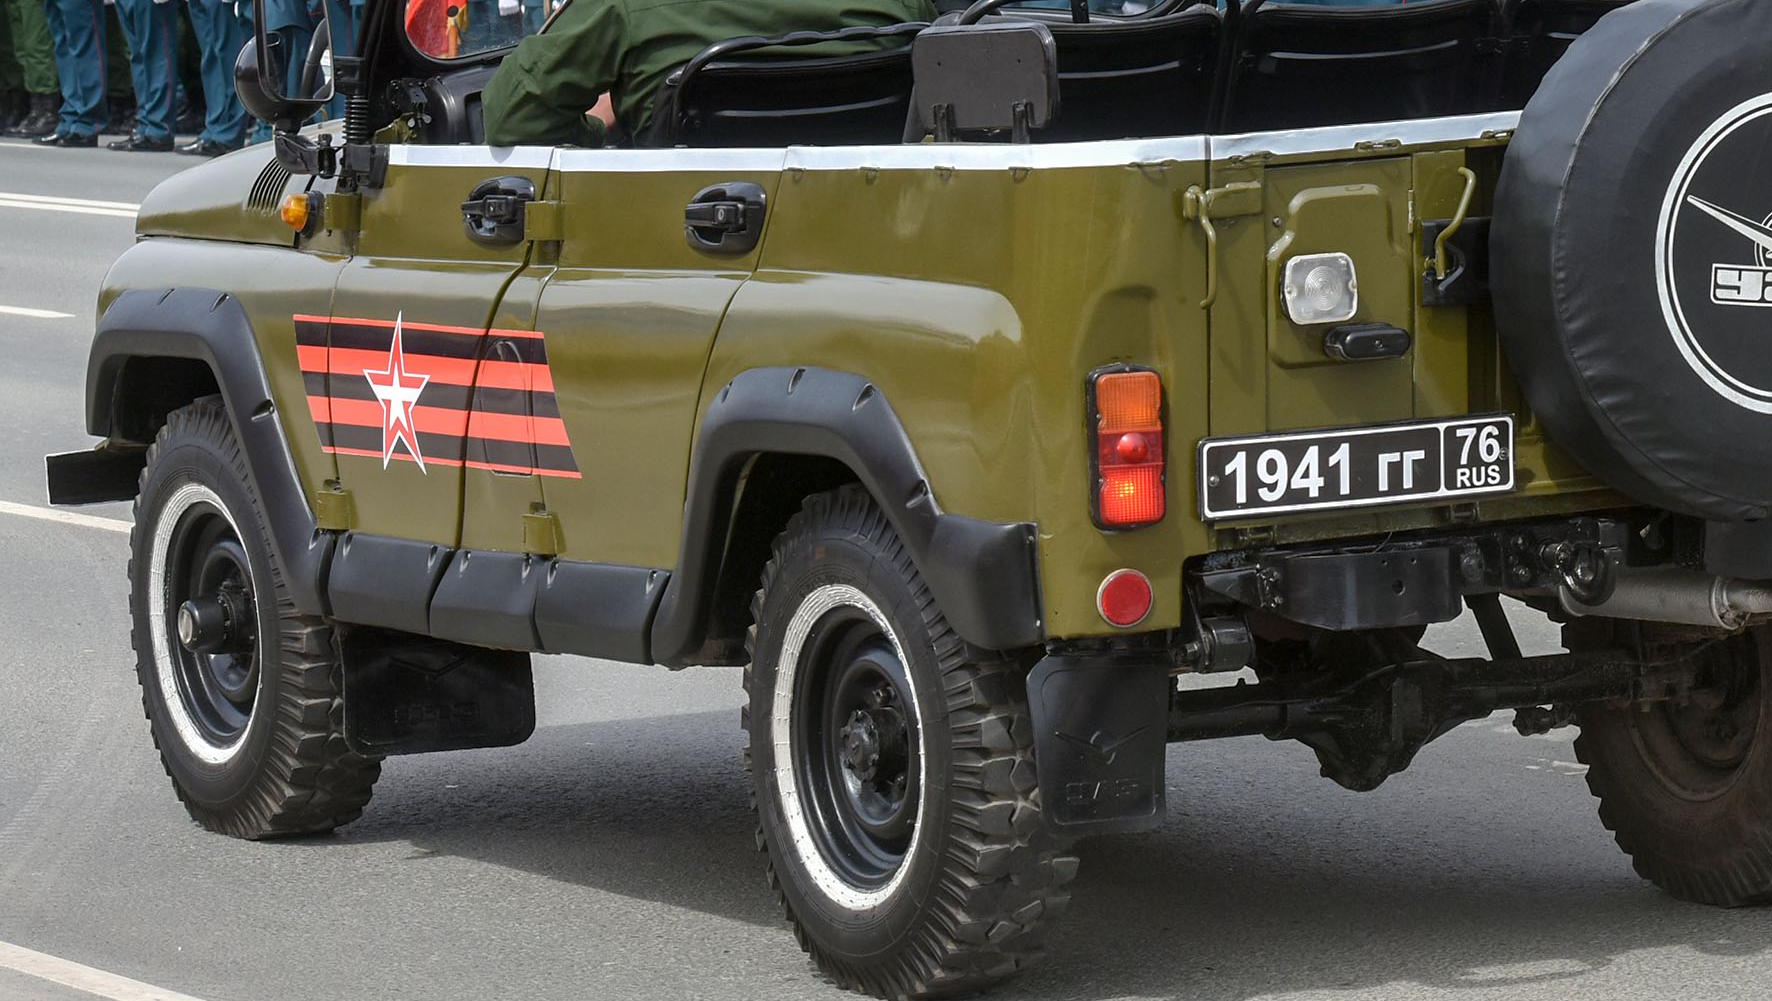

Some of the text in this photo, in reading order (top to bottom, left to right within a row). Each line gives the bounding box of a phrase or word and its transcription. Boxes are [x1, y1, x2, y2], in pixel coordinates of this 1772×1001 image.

[1455, 425, 1500, 465] 76
[1224, 443, 1350, 503] 1941
[1456, 465, 1501, 488] RUS
